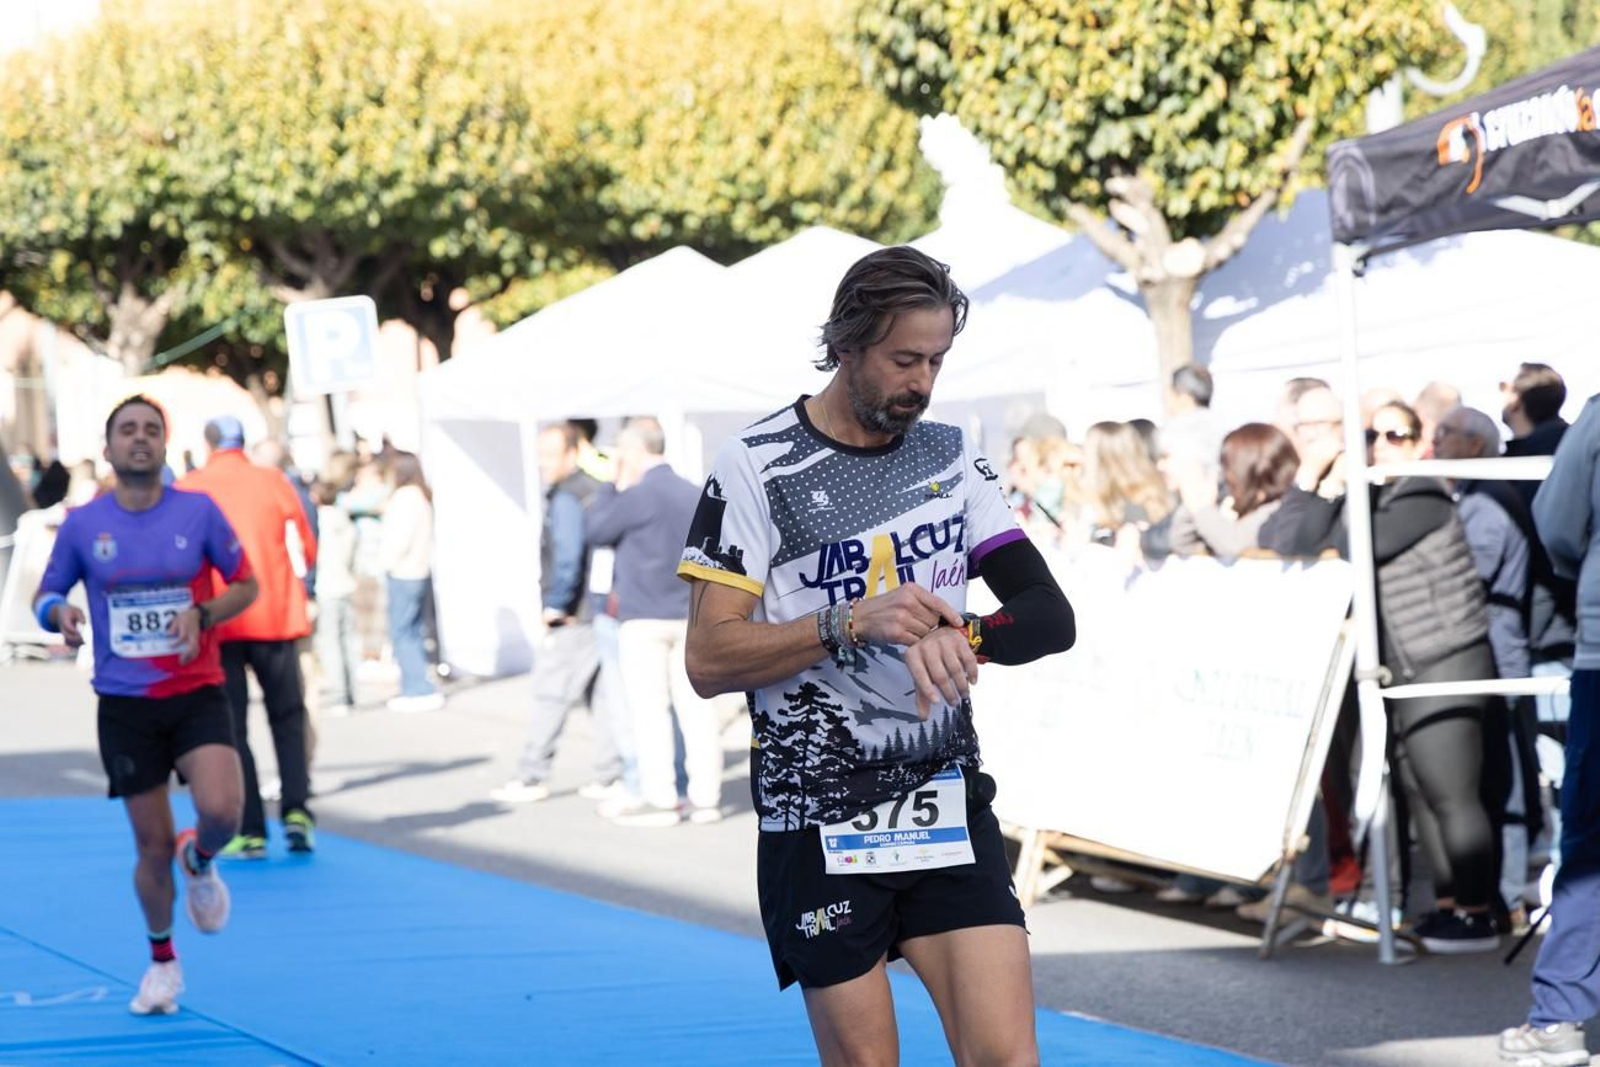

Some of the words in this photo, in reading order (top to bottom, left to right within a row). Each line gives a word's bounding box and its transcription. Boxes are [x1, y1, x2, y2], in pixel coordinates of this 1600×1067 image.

[304, 310, 361, 382] P
[799, 516, 964, 589] JABALCUZ
[864, 833, 892, 844] PEDRO
[894, 831, 931, 841] MANUEL
